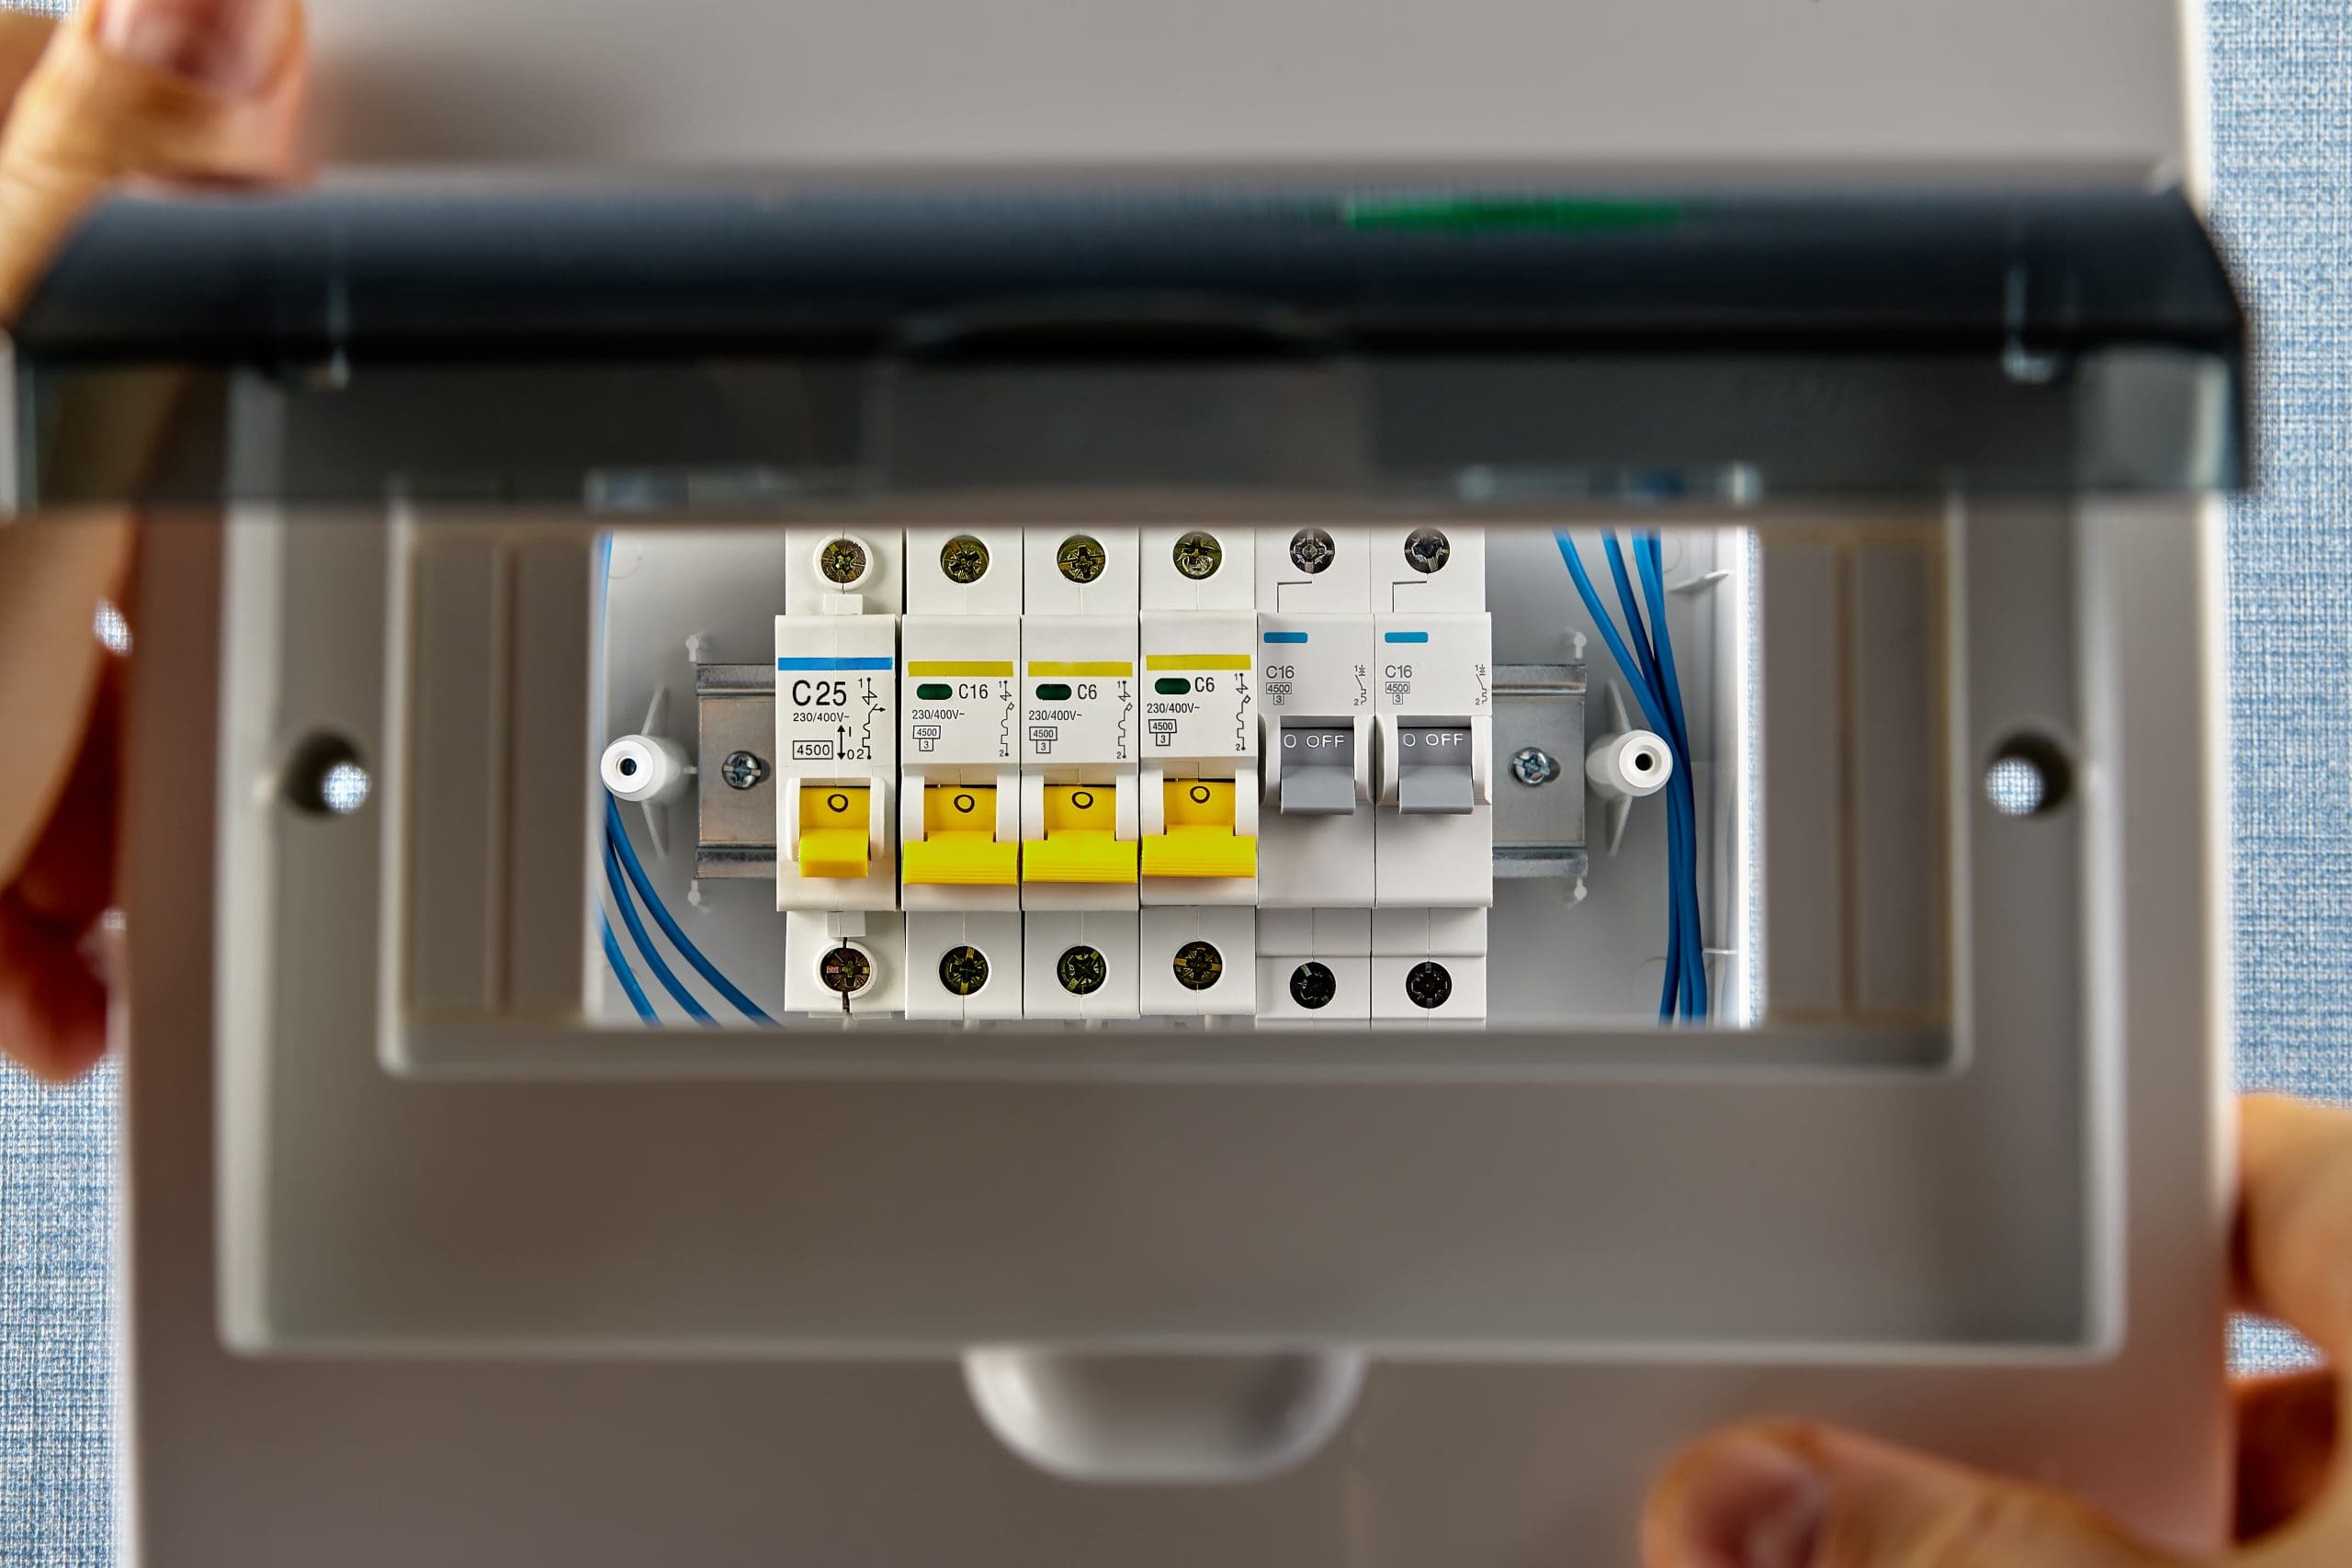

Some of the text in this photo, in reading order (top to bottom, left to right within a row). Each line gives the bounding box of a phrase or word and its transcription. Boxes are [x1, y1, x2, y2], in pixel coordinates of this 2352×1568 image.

[1266, 665, 1295, 679] C16
[1385, 664, 1413, 678] C16
[858, 678, 863, 688] 1
[1194, 676, 1215, 693] C6
[1386, 683, 1408, 693] 4500
[792, 679, 847, 706] C25
[958, 683, 989, 700] C16
[1077, 683, 1097, 700] C6
[1267, 684, 1291, 693] 4500
[1275, 694, 1283, 704] 3
[1395, 694, 1401, 703] 3
[1152, 722, 1173, 730] 4500
[917, 728, 937, 737] 4500
[1033, 729, 1054, 739] 4500
[1160, 735, 1166, 743] 3
[1306, 735, 1345, 748] OFF
[1426, 733, 1464, 746] OFF
[923, 740, 929, 749] 3
[1040, 742, 1046, 750] 3
[1235, 743, 1240, 751] 2
[797, 744, 831, 756] 4500
[856, 749, 865, 760] 2
